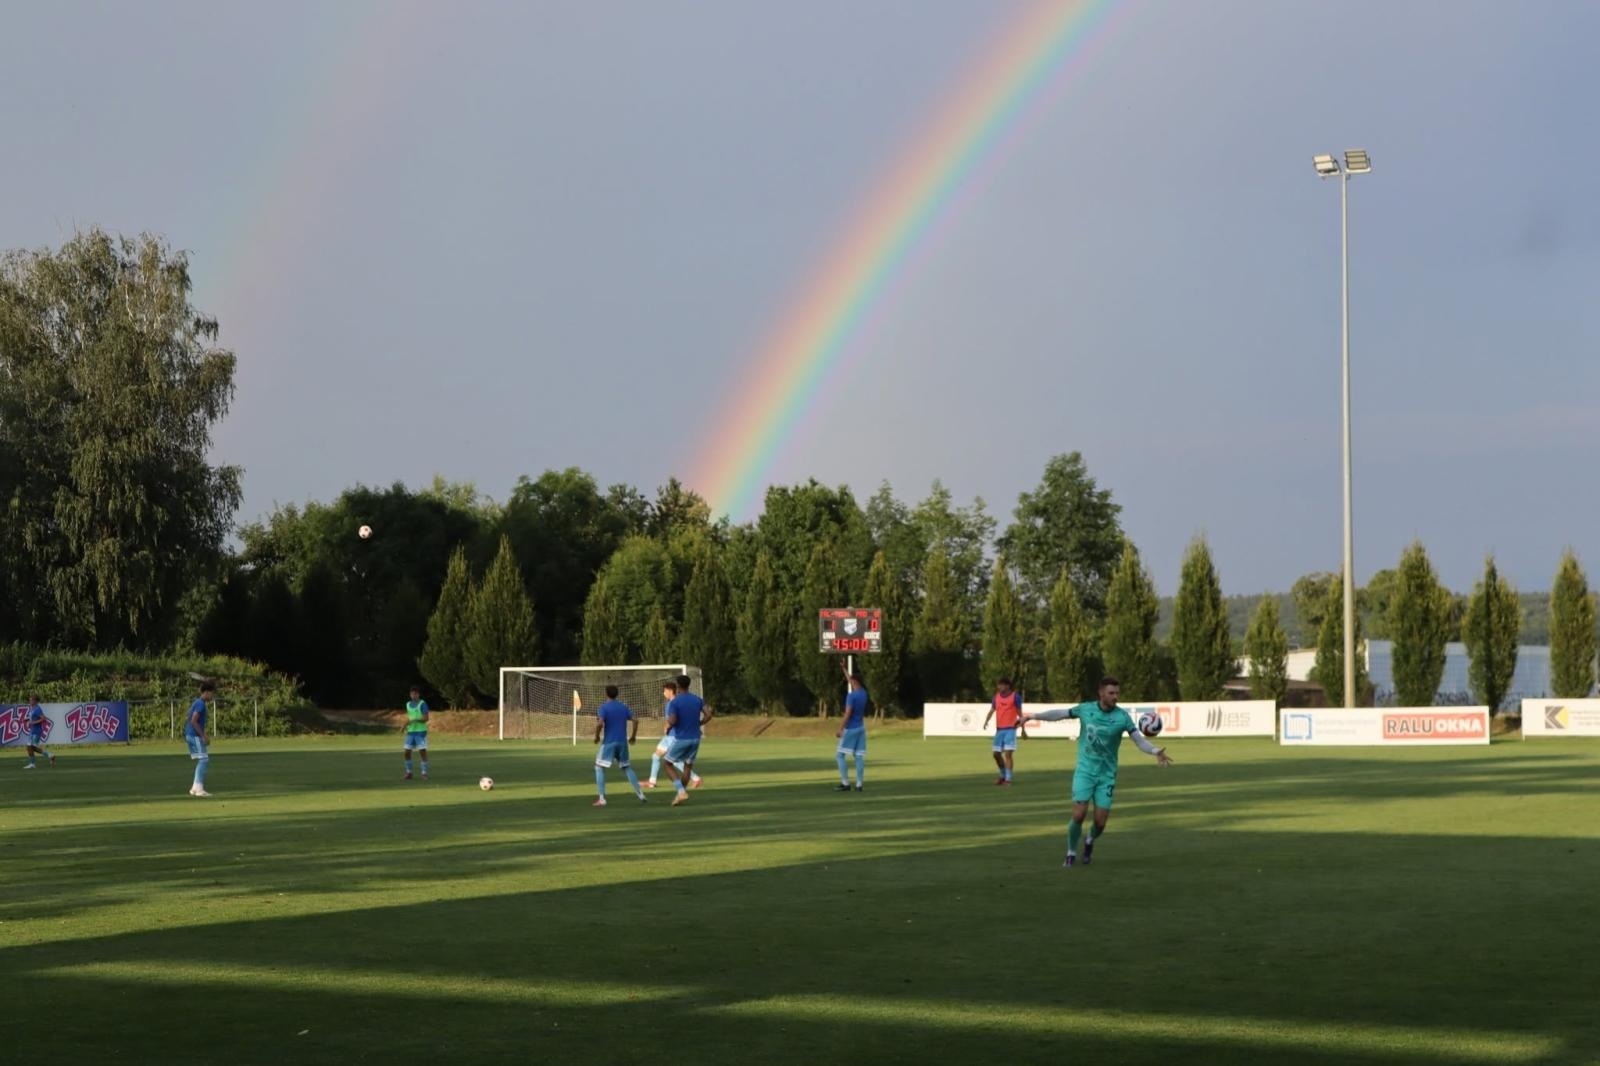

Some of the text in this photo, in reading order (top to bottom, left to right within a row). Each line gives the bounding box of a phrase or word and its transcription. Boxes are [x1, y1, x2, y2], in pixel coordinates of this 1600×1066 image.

[833, 639, 868, 650] 45:00
[1387, 719, 1432, 733] RALU
[1435, 718, 1482, 733] OKNA
